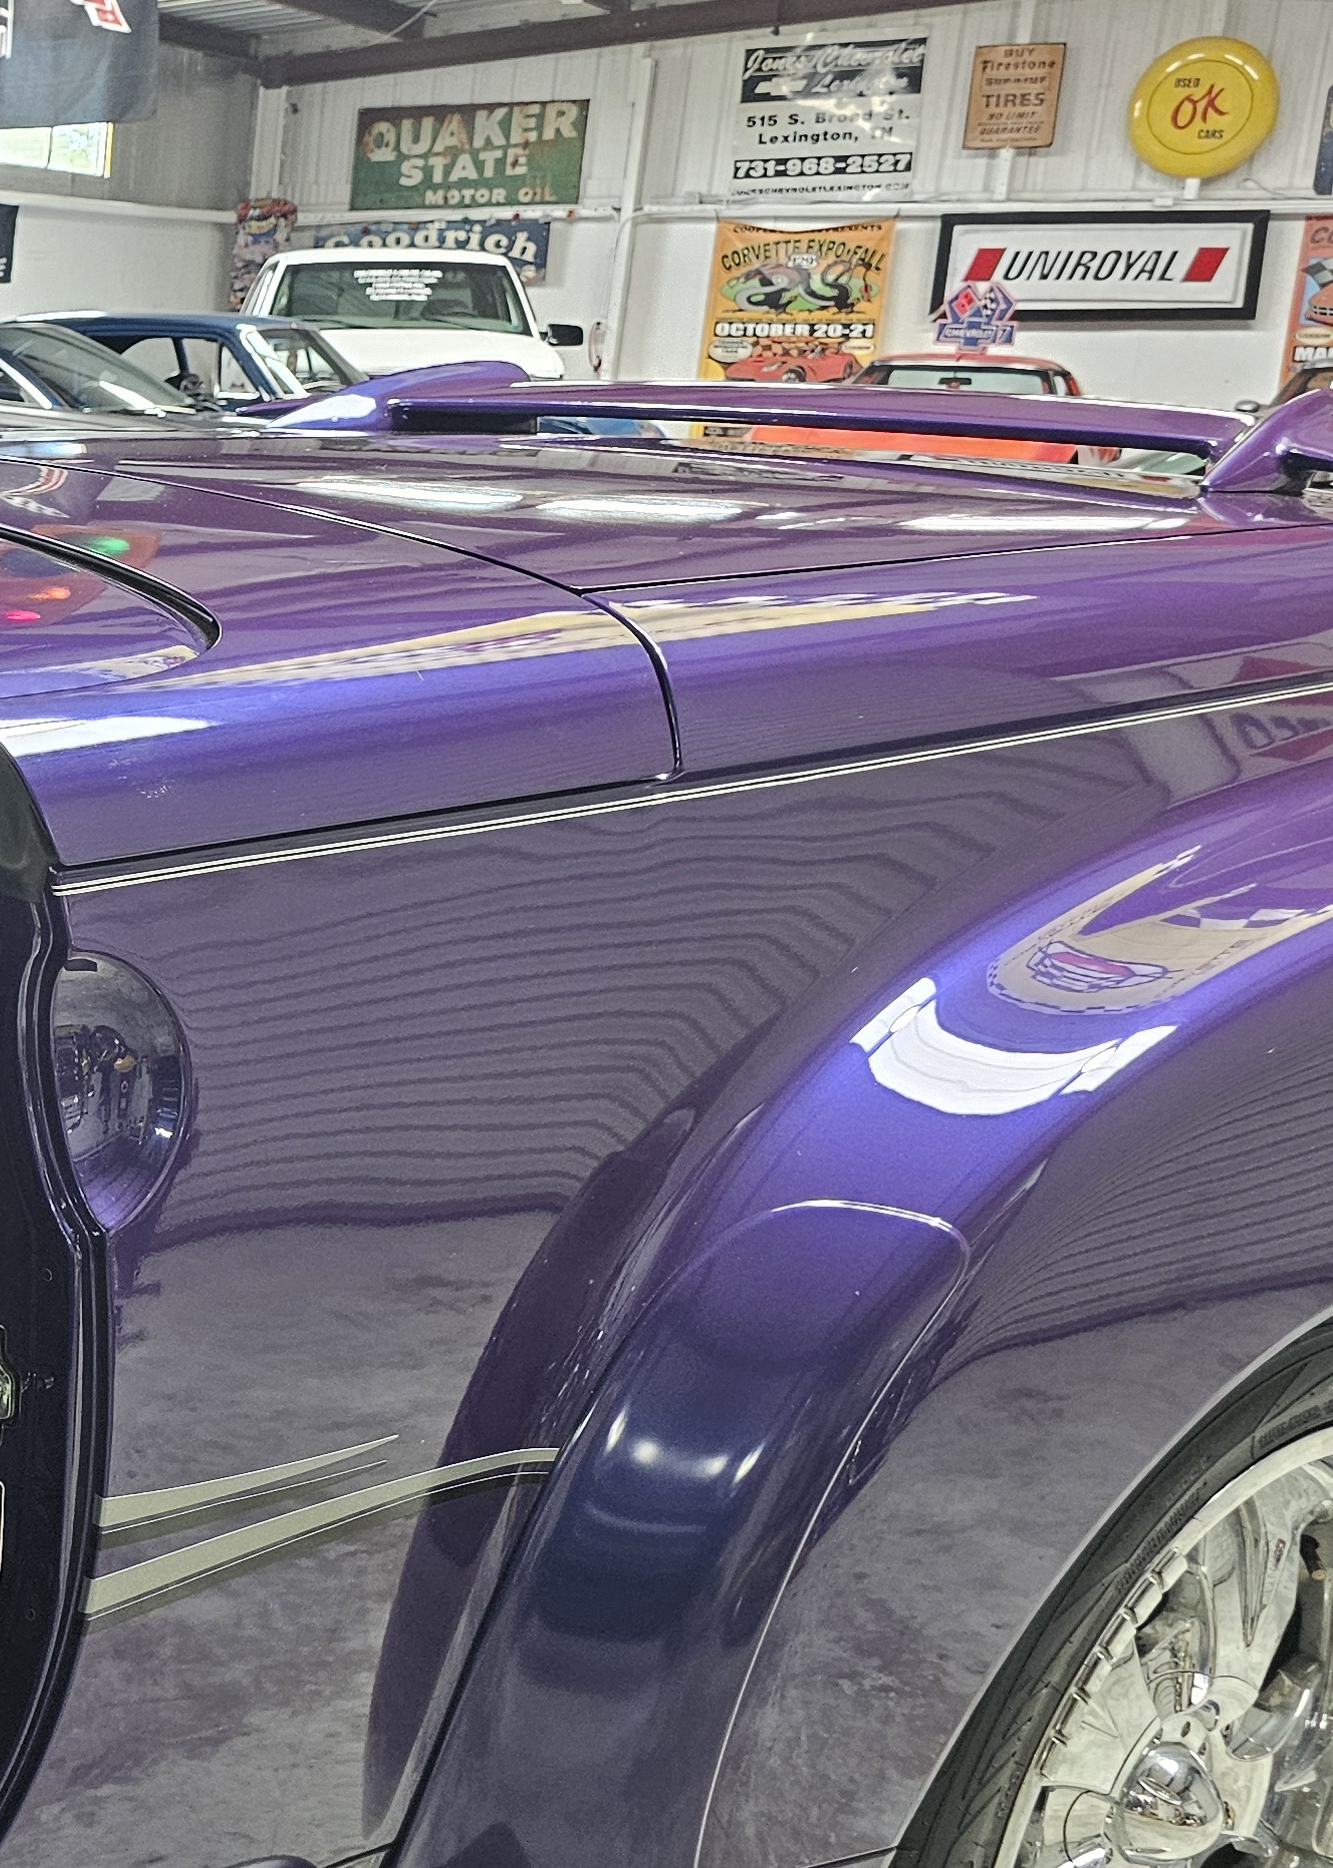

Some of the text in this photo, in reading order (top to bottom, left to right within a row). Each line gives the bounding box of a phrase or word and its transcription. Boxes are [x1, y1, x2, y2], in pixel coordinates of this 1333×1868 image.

[1003, 47, 1036, 59] BUY
[979, 60, 1057, 73] Firestone
[1174, 77, 1201, 89] USED
[980, 91, 1046, 109] TIRES
[1170, 82, 1230, 131] OK
[746, 114, 779, 128] 515
[788, 113, 805, 126] S.
[362, 101, 579, 162] QUAKER
[757, 130, 860, 145] Lexington,
[1197, 129, 1225, 140] CARS
[398, 146, 531, 187] STATE
[735, 154, 912, 178] 731-968-2527
[424, 185, 557, 206] MOTOR OIL
[721, 239, 802, 271] CORVETTE
[1002, 249, 1179, 282] UNIROYAL
[715, 322, 875, 338] OCTOBER 20-21
[1293, 346, 1333, 362] MA
